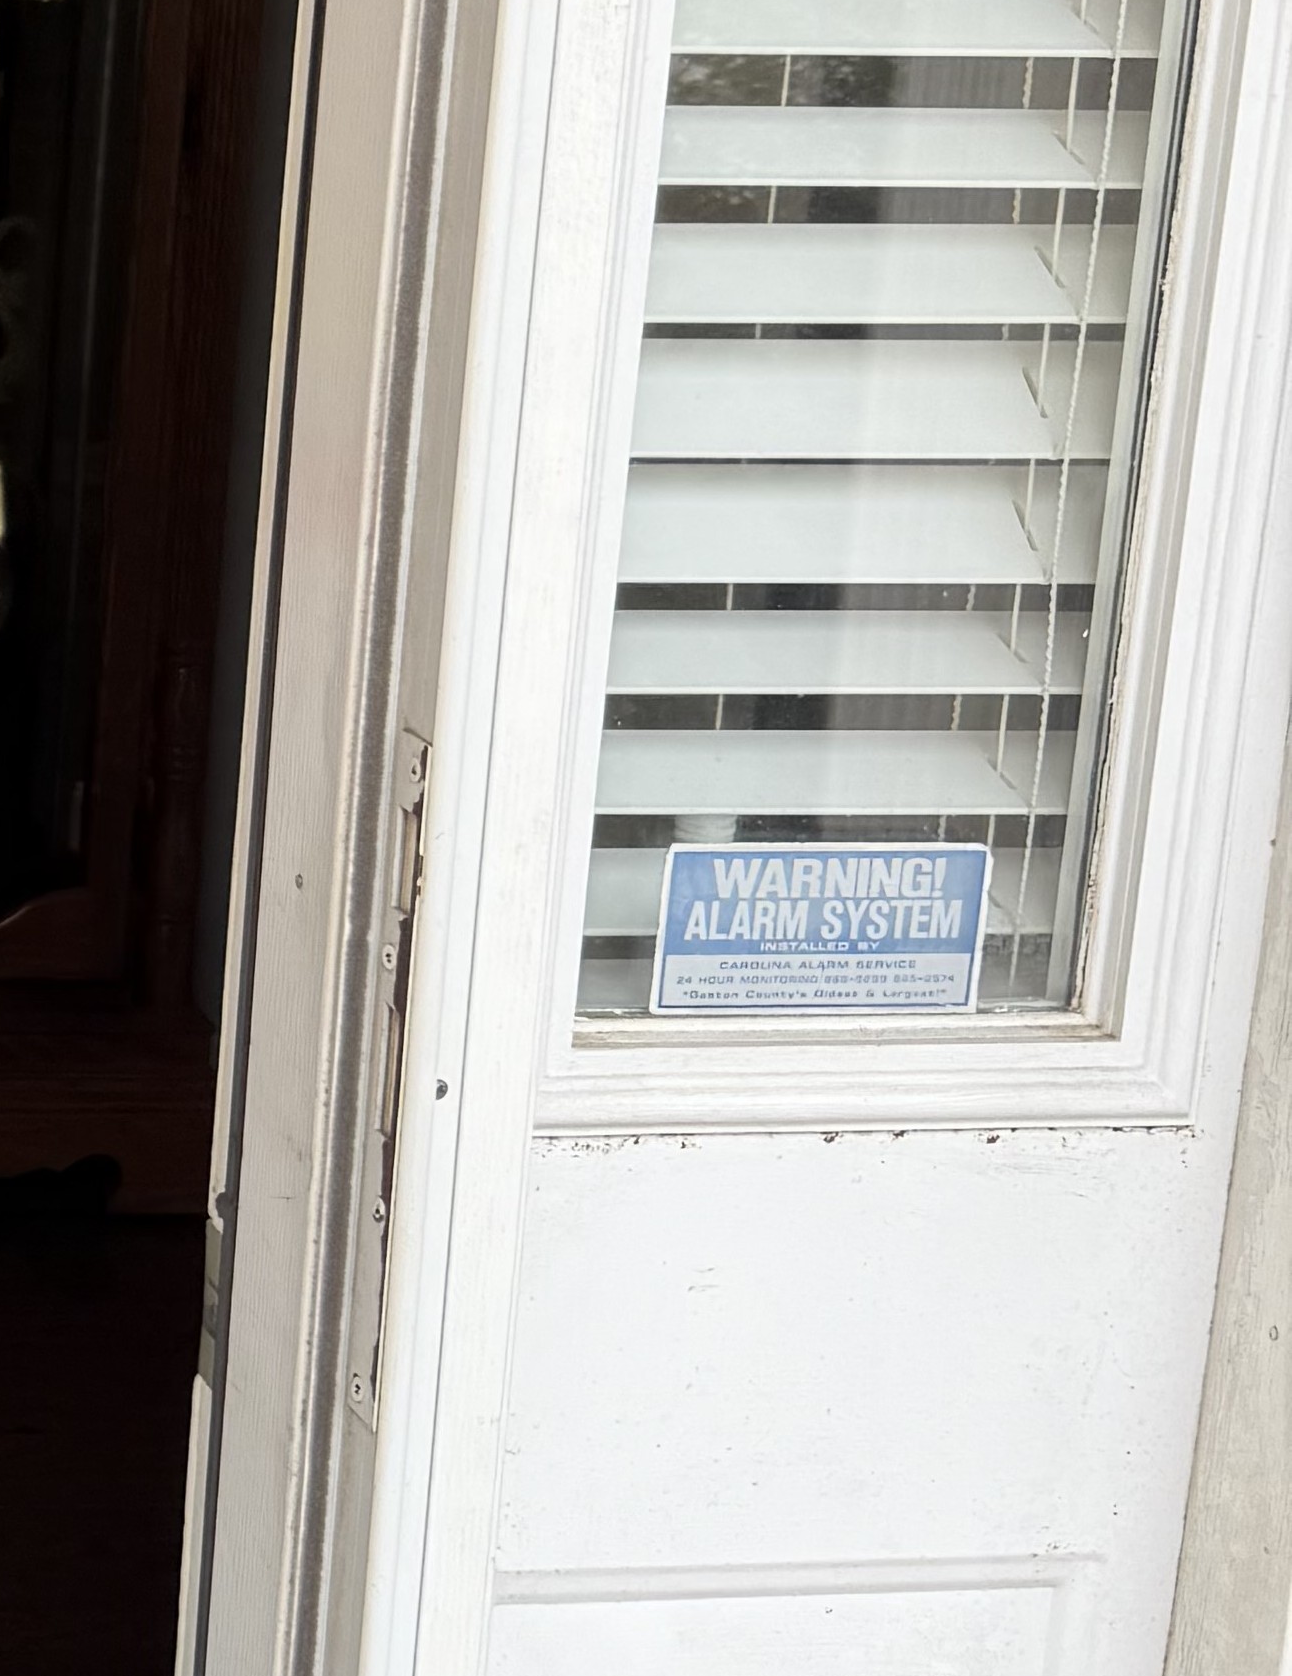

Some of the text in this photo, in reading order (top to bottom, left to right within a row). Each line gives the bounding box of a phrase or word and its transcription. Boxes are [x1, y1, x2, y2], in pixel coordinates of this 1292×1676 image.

[713, 858, 947, 900] WARNING!
[684, 899, 963, 941] ALARM SYSTEM
[760, 942, 881, 951] INSTALLED BY
[720, 960, 917, 971] CAROLINA ALARM SERVICE
[677, 976, 692, 985] 24
[699, 976, 734, 984] HOUR
